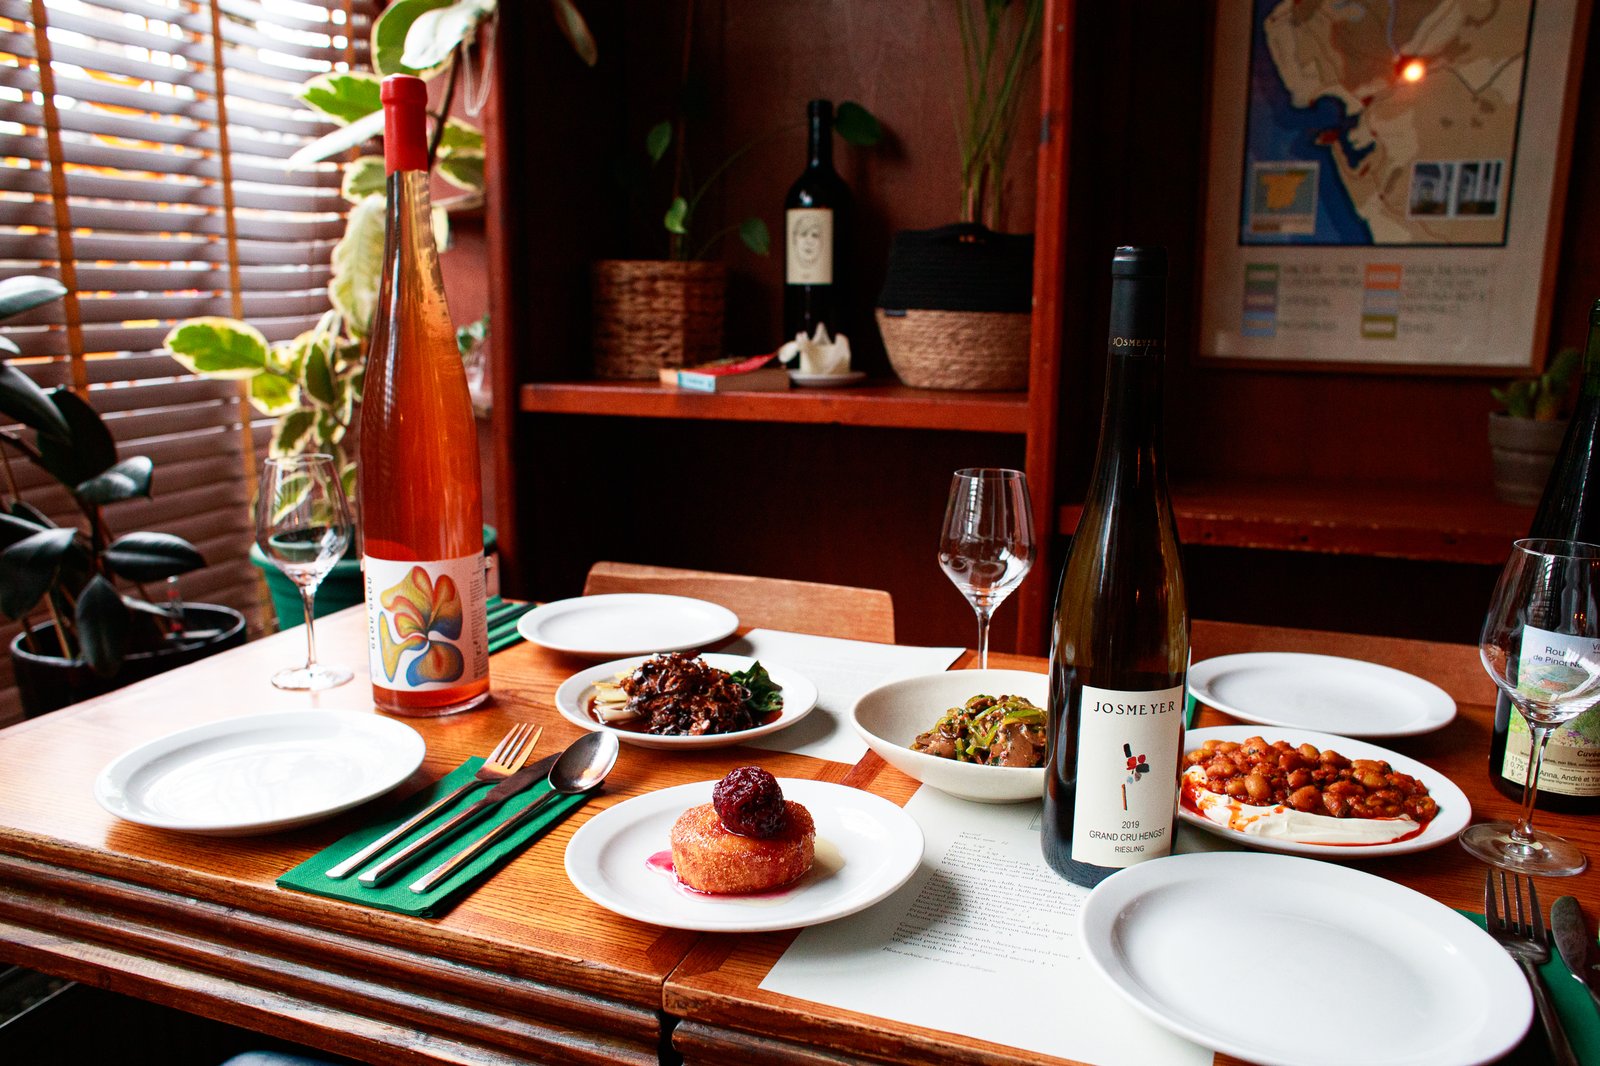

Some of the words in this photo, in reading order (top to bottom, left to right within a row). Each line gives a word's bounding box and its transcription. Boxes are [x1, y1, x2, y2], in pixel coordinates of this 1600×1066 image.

[1112, 336, 1156, 347] JOSMEY
[1094, 701, 1174, 716] JOSMEYER
[1122, 820, 1140, 829] 2019
[1089, 830, 1118, 842] GRAND
[1120, 831, 1138, 842] CRU
[1138, 828, 1165, 840] HENGST
[1114, 845, 1145, 854] RIESLING
